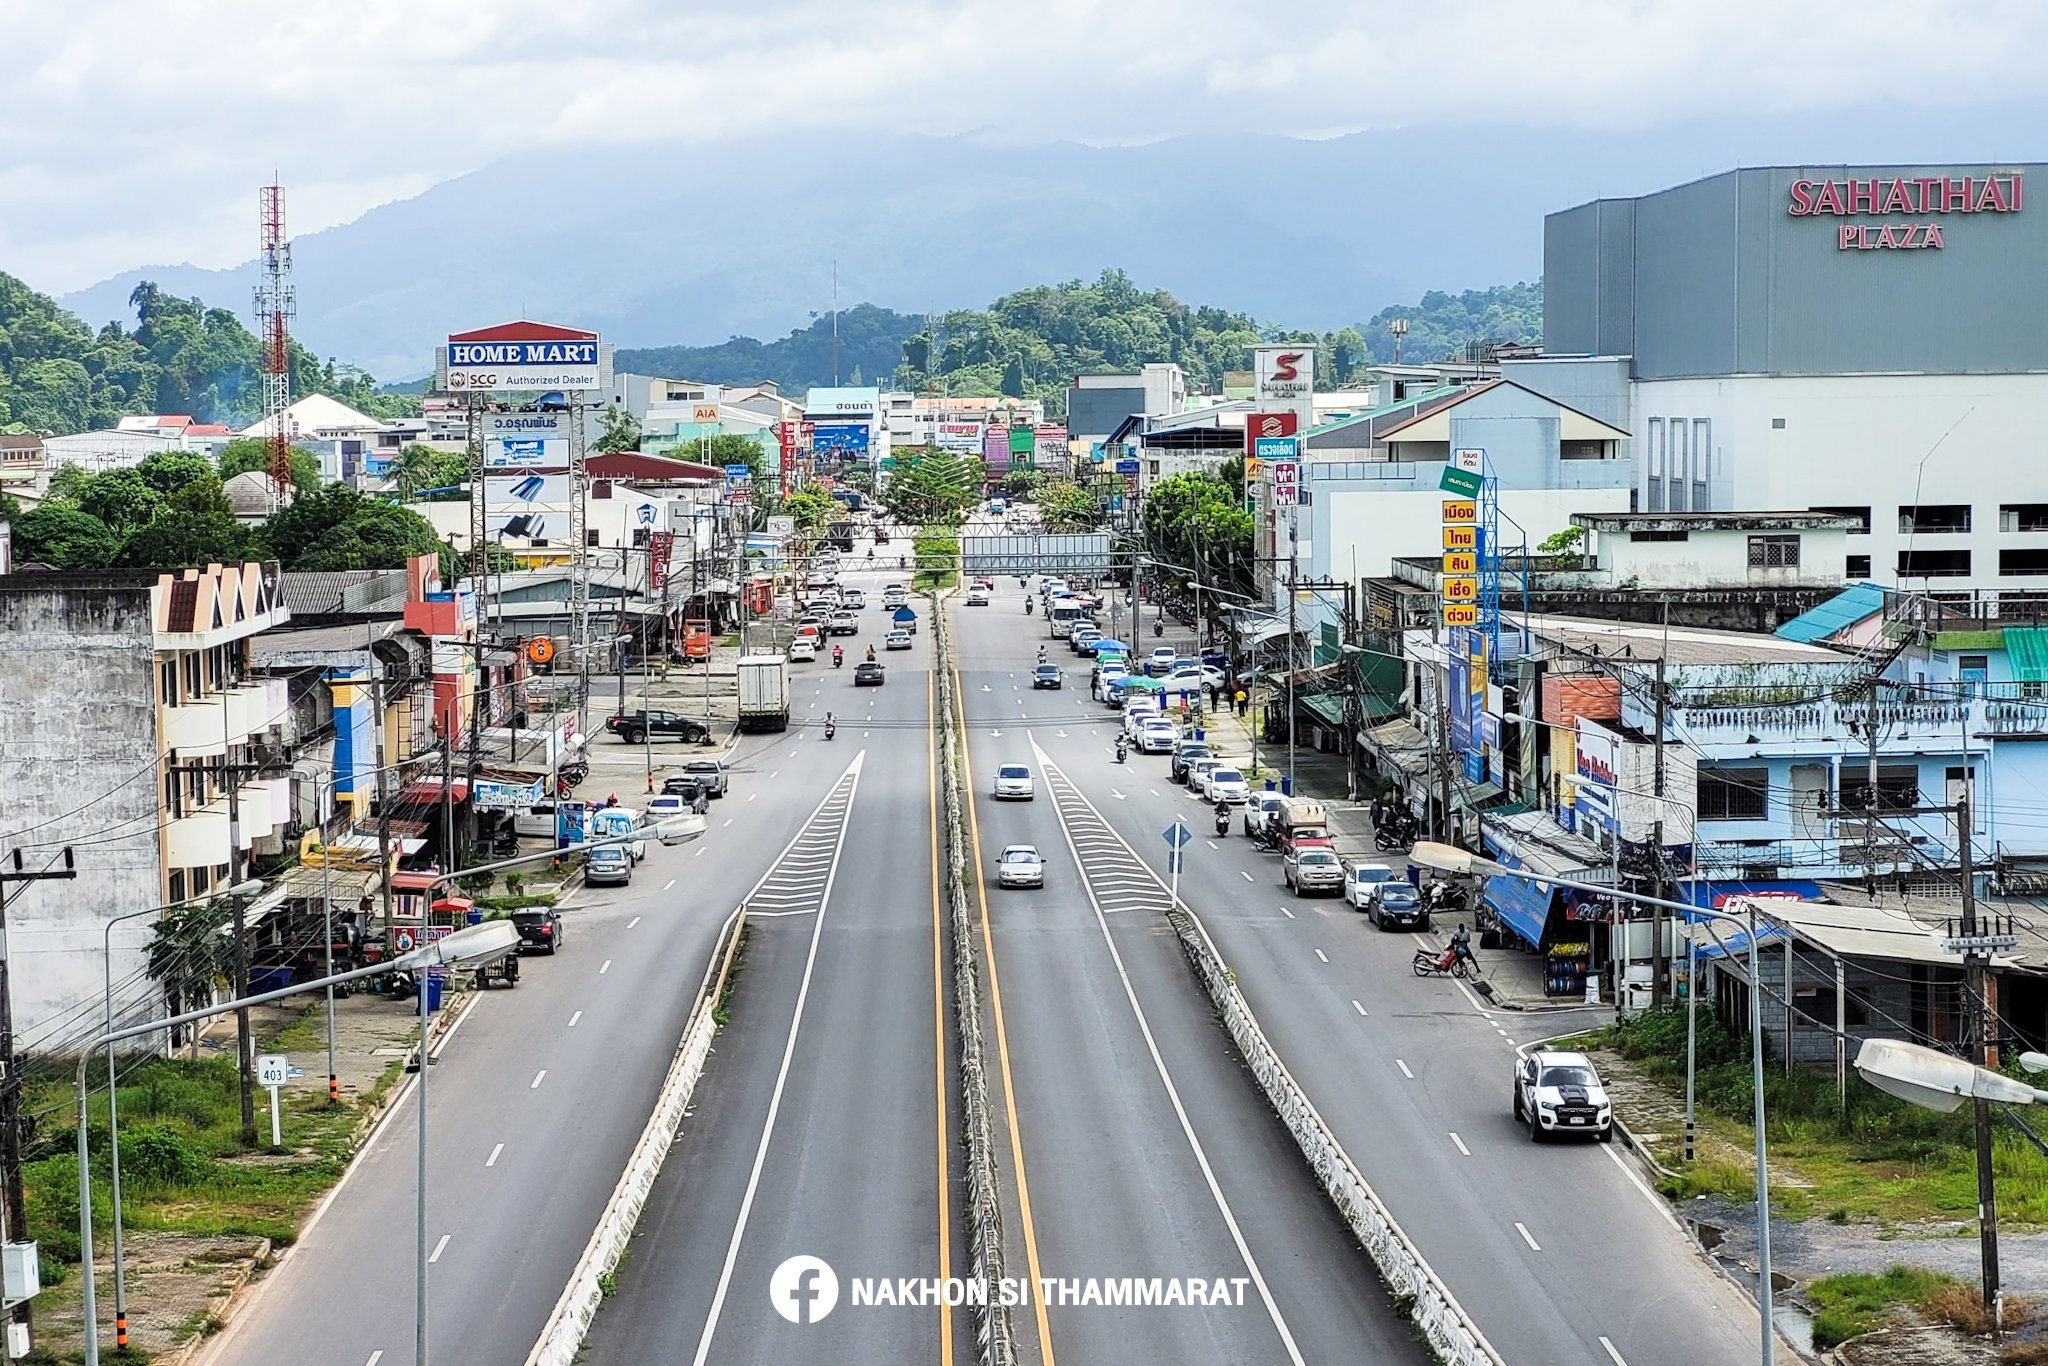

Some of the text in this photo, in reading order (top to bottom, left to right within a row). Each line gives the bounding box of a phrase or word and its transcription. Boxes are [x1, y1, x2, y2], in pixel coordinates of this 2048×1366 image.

[1789, 175, 2023, 216] SAHATHAI
[1839, 223, 1944, 250] PLAZA
[453, 344, 595, 363] HOME MART
[470, 374, 497, 385] SCG
[506, 375, 594, 385] Authorized Dealer
[695, 409, 717, 419] AIA
[1258, 442, 1294, 456] ตรวจเลือด
[1277, 465, 1295, 482] ทำ
[1277, 487, 1296, 505] ฟัน
[1444, 505, 1474, 519] เมือง
[1449, 529, 1472, 544] ไทย
[1451, 557, 1469, 570] สิน
[1449, 580, 1471, 596] เชื่อ
[1447, 608, 1473, 622] ด่วน
[263, 1069, 282, 1081] 403
